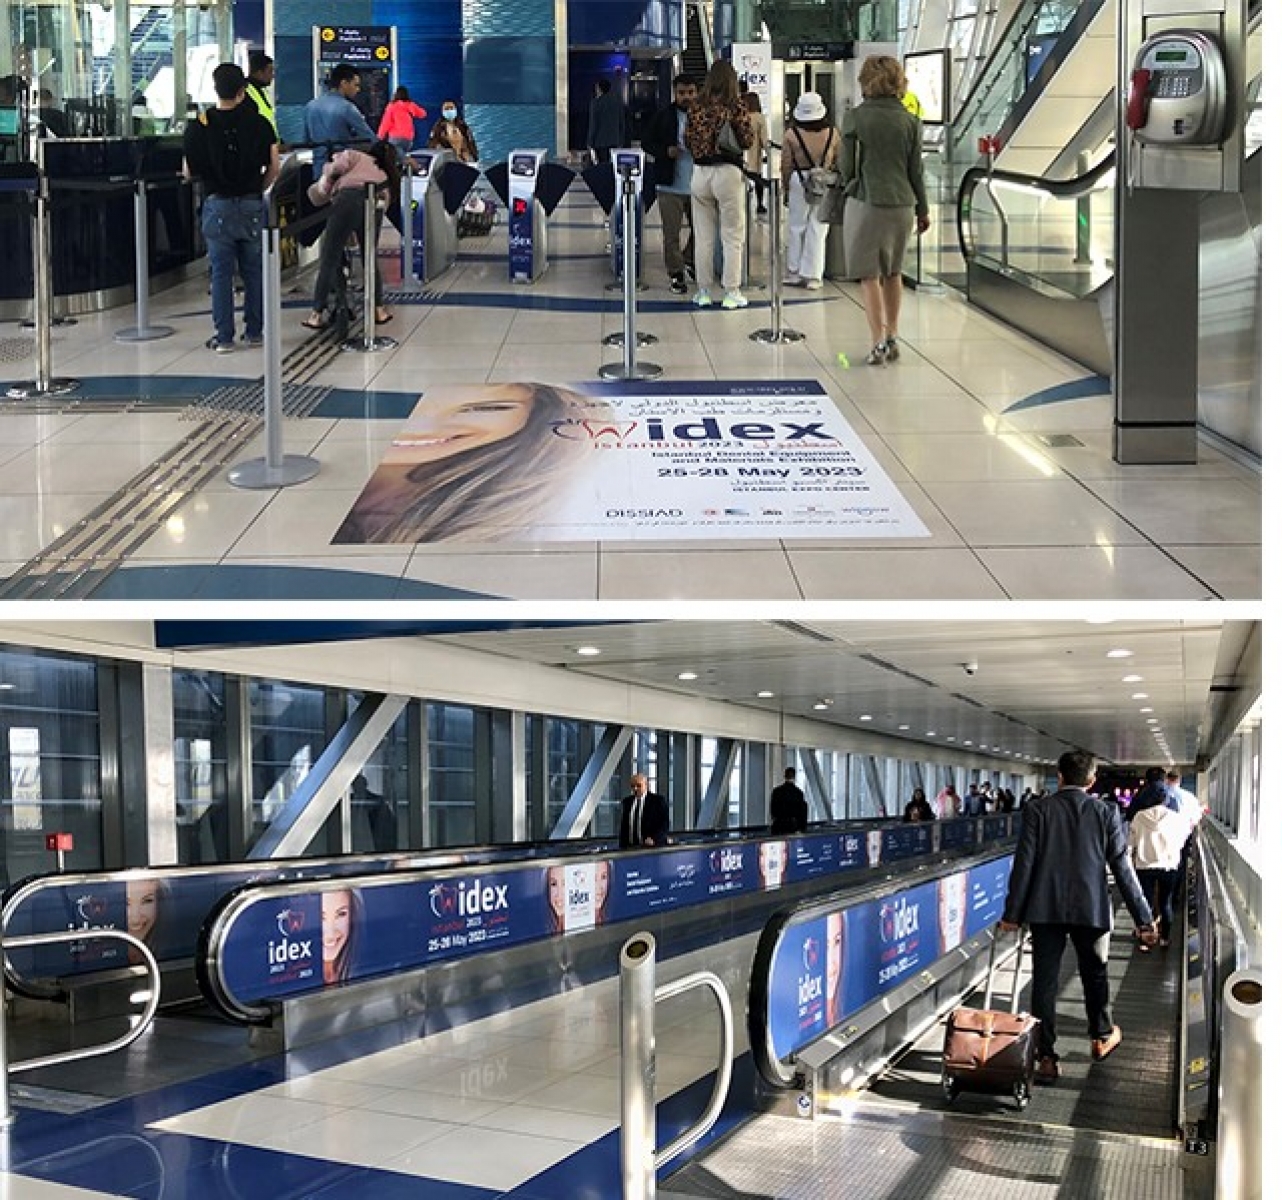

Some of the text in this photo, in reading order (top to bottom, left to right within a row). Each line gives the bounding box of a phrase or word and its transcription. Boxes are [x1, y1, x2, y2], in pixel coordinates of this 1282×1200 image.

[646, 417, 836, 441] idex
[658, 467, 865, 478] 25-28 May 2023
[458, 879, 508, 916] idex
[894, 897, 919, 941] idex
[268, 939, 312, 964] idex
[799, 974, 822, 1005] idex
